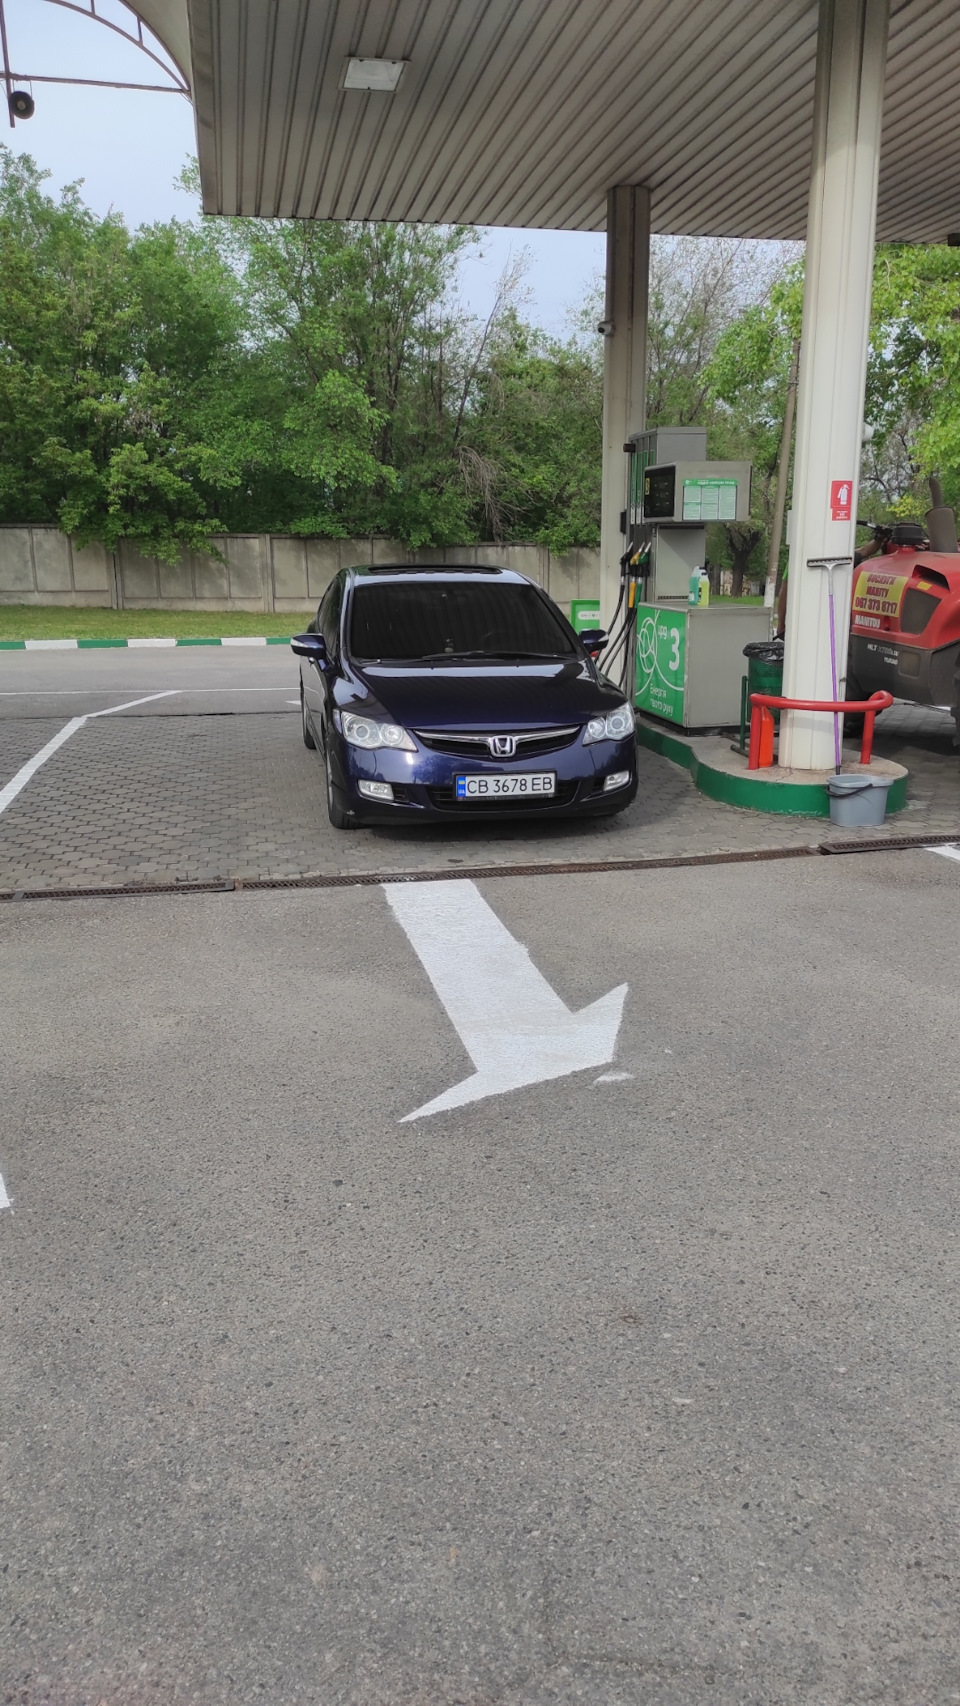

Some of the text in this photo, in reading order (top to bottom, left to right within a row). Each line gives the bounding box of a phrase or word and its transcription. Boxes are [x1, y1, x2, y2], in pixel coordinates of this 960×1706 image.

[855, 597, 897, 614] 067 373 8717
[855, 615, 880, 628] MANITOU
[669, 627, 680, 671] 3
[467, 776, 553, 794] CB 3678 EB
